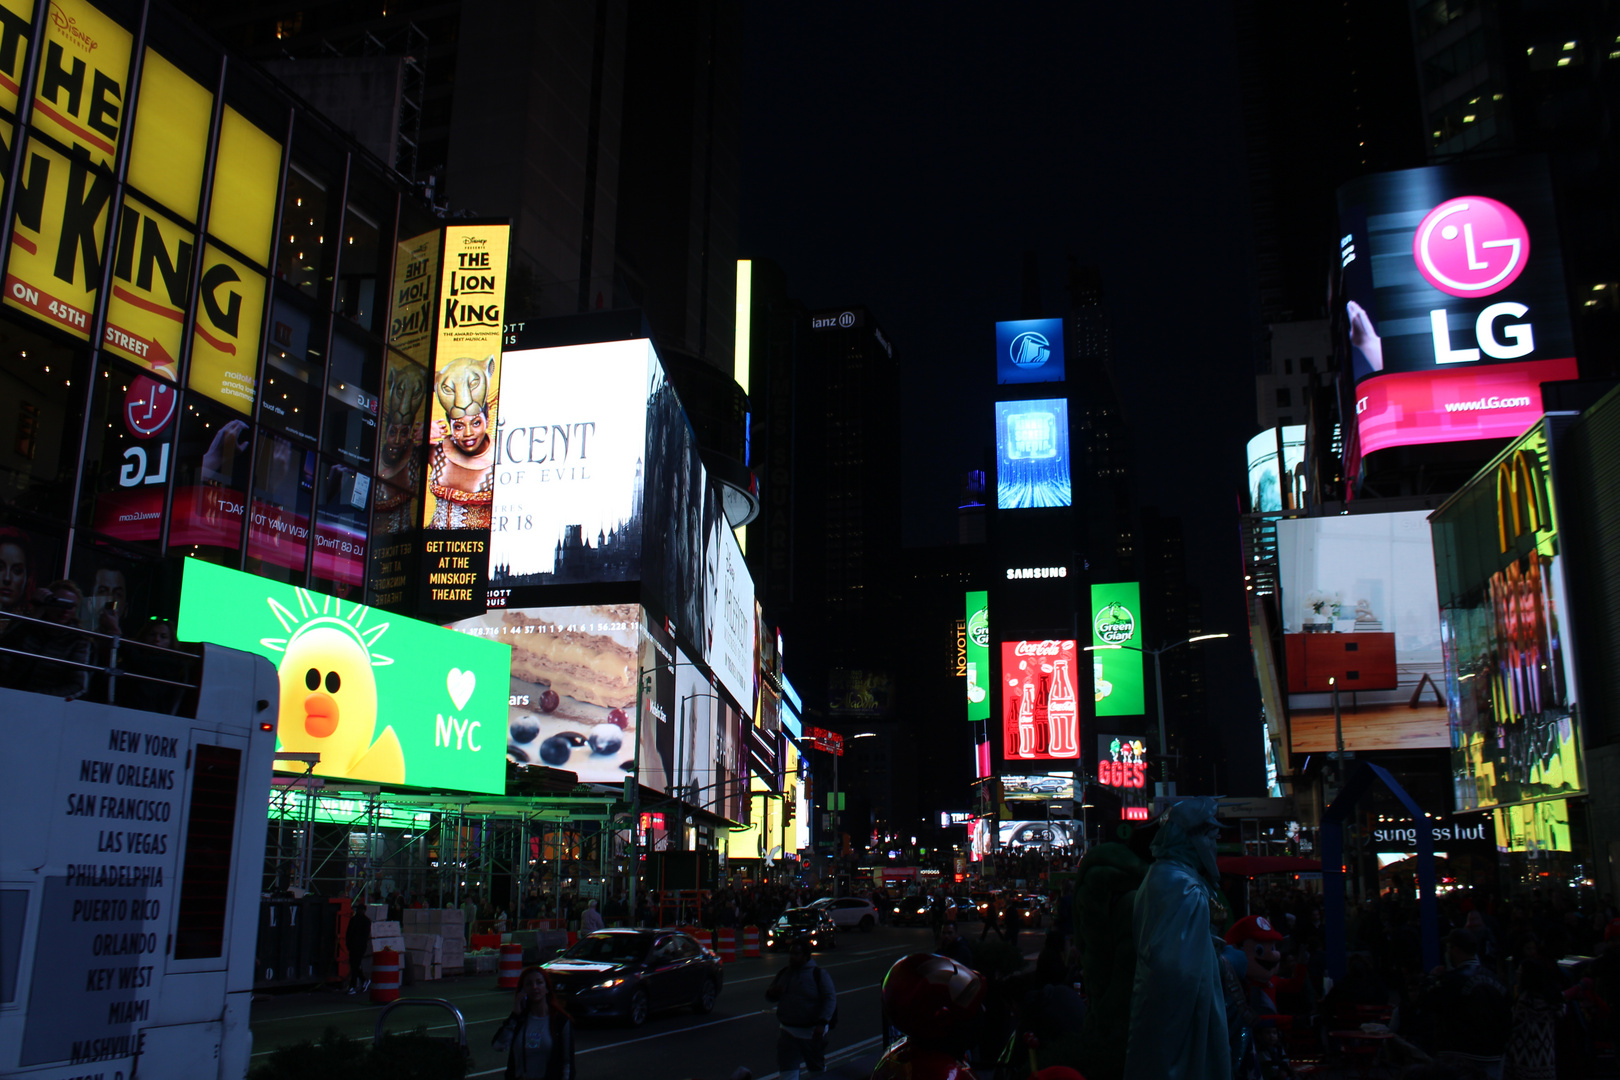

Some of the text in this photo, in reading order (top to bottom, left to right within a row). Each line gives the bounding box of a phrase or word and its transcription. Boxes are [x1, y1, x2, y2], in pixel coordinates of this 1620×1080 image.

[54, 142, 242, 339] KING
[458, 253, 489, 266] THE
[450, 271, 495, 296] LION
[13, 283, 86, 329] ON 45TH
[444, 298, 499, 329] KING
[106, 327, 149, 358] STREET
[1430, 302, 1534, 364] LG
[1445, 396, 1530, 412] www.LG.com
[500, 466, 591, 486] OF EVIL
[517, 514, 533, 531] 18
[426, 541, 484, 553] GET TICKETS
[438, 557, 469, 569] AT THE
[1006, 567, 1067, 580] SAMSUNG
[429, 573, 477, 585] MINSKOFF
[432, 589, 473, 601] THEATRE
[510, 626, 521, 634] 44
[525, 626, 535, 634] 37
[567, 624, 577, 632] 41
[580, 624, 586, 632] 6
[597, 622, 627, 631] 56.228
[1100, 623, 1132, 632] Green
[1103, 630, 1133, 641] Giant
[956, 619, 967, 676] NOVOTEL
[108, 729, 178, 759] NEW YORK
[435, 713, 482, 752] NYC
[80, 759, 175, 790] NEW ORLEANS
[66, 793, 171, 823] SAN FRANCISCO
[98, 831, 167, 855] LAS VEGAS
[1454, 823, 1486, 840] hut
[65, 863, 163, 888] PHILADELPHIA
[72, 899, 160, 922] PUERTO RICO
[93, 932, 156, 956] ORLANDO
[86, 966, 154, 992] KEY WEST
[107, 1000, 149, 1025] MIAMI
[70, 1033, 146, 1065] NASHVILLE
